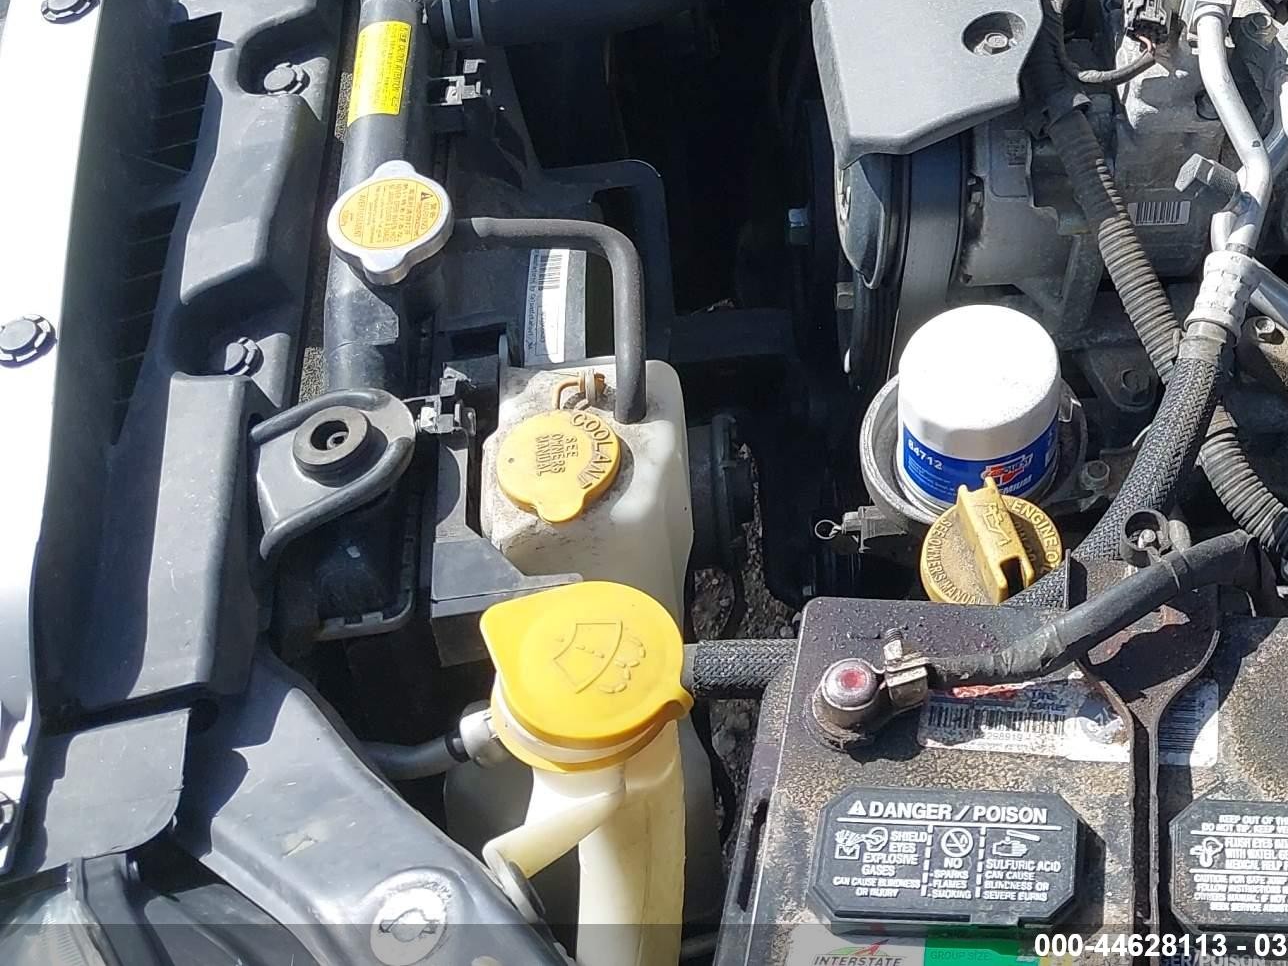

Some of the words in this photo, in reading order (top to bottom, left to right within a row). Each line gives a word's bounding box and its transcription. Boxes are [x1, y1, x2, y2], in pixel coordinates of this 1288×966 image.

[565, 436, 578, 458] SEE
[571, 413, 614, 490] COOLANT
[536, 435, 552, 476] MANUAL
[908, 438, 943, 470] 84712
[932, 518, 952, 538] SEE
[1012, 500, 1058, 548] ENGINE
[868, 801, 953, 820] DANGER
[972, 806, 1048, 824] POISON
[1241, 815, 1261, 825] OUT
[1261, 816, 1274, 825] OF
[890, 830, 928, 843] SHIELD
[888, 842, 917, 854] EYES
[862, 852, 920, 866] EXPLOSIVE
[944, 857, 964, 869] NO
[986, 858, 1036, 870] SULFURIC
[1036, 860, 1062, 873] ACID
[861, 864, 896, 877] GASES
[984, 870, 1004, 880] CAN
[1006, 871, 1036, 881] CAUSE
[832, 876, 850, 886] CAN
[850, 877, 877, 888] CAUSE
[1034, 882, 1050, 892] OR
[856, 886, 869, 897] OR
[813, 956, 903, 966] INTERSTATE
